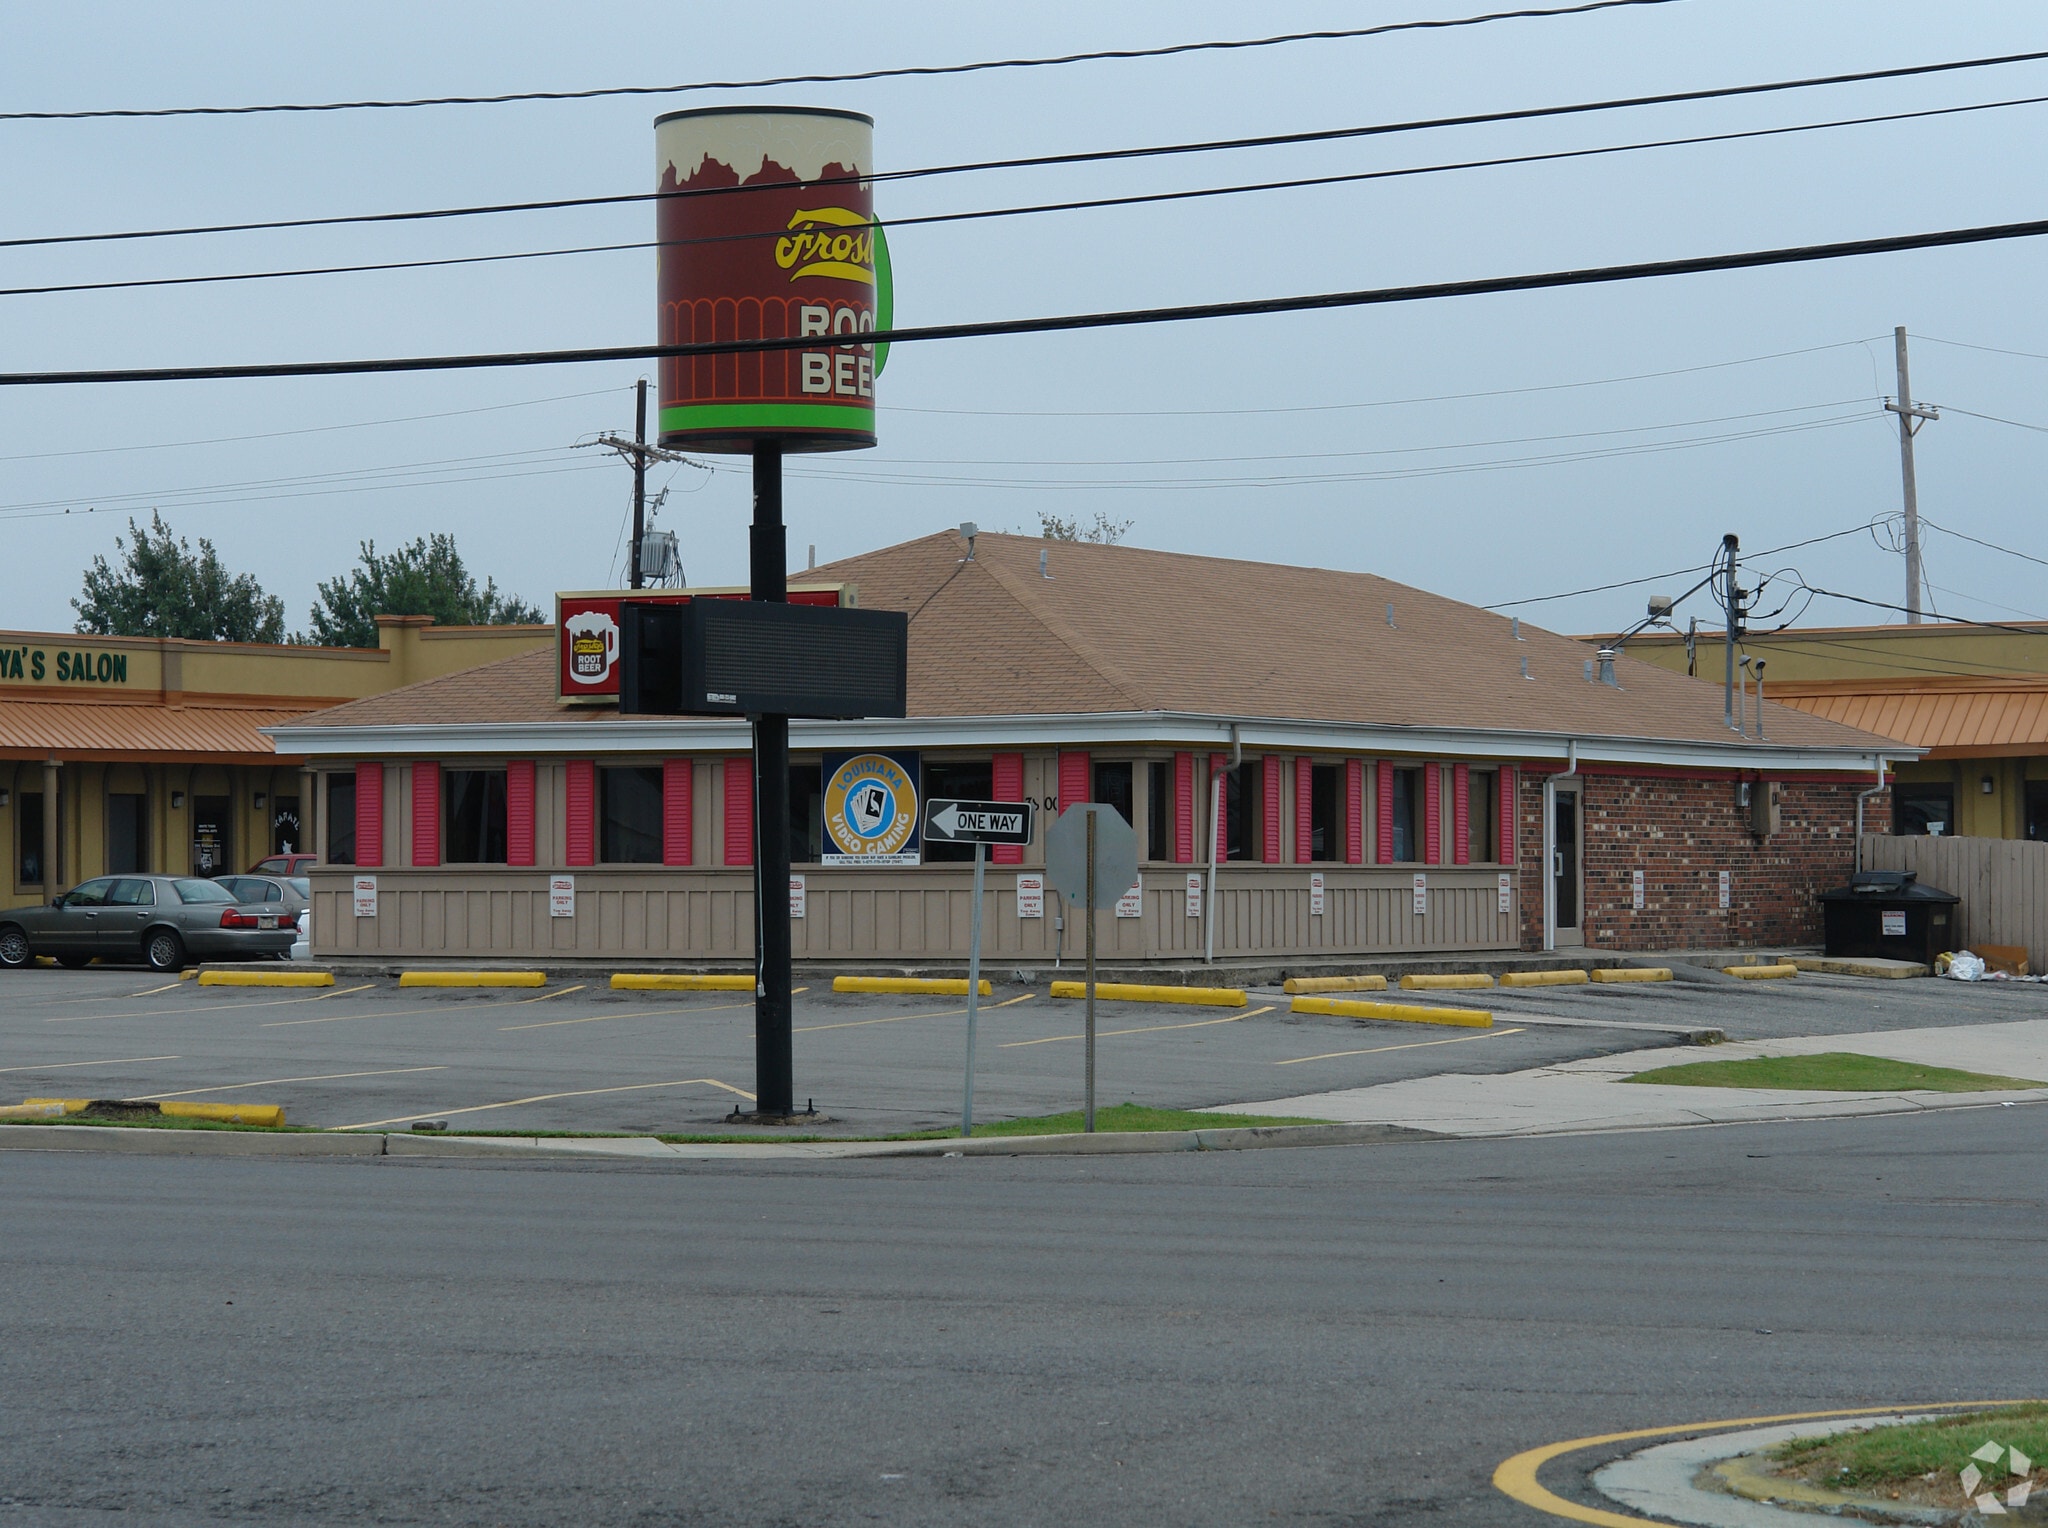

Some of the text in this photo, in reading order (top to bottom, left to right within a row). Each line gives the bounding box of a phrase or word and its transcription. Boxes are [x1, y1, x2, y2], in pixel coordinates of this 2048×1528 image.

[801, 305, 875, 352] ROO
[801, 352, 875, 399] BEE
[57, 650, 127, 683] SALON
[578, 655, 601, 664] ROOT
[578, 664, 601, 672] BEER
[836, 760, 903, 791] LOUISIANA
[831, 812, 910, 854] VIDEO GAMING
[957, 813, 1018, 831] ONE WAY
